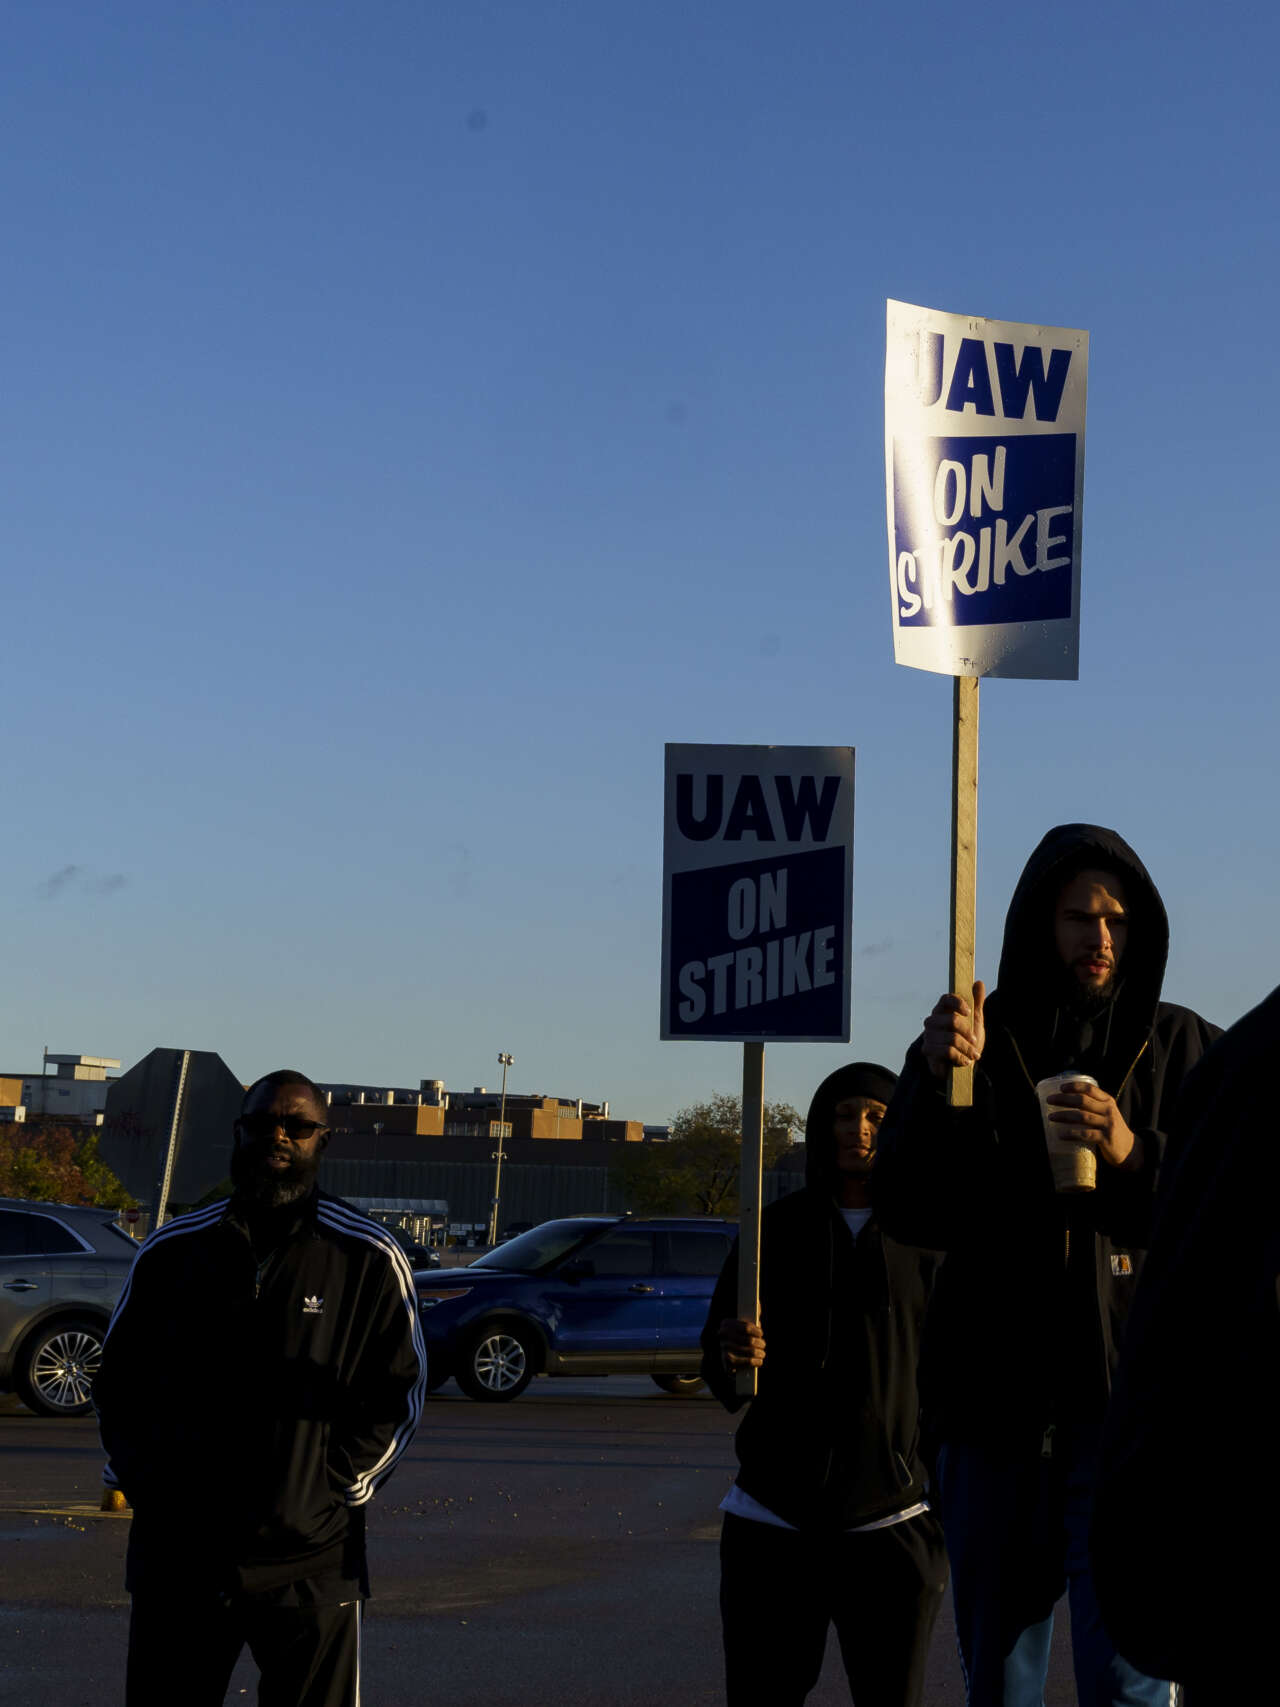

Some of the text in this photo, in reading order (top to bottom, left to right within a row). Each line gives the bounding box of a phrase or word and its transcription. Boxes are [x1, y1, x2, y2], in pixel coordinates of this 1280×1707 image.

[912, 331, 1073, 423] UAW
[934, 445, 1007, 526] ON
[897, 503, 1073, 618] STRIKE
[676, 773, 842, 842] UAW
[727, 867, 788, 941] ON
[678, 924, 836, 1023] STRIKE
